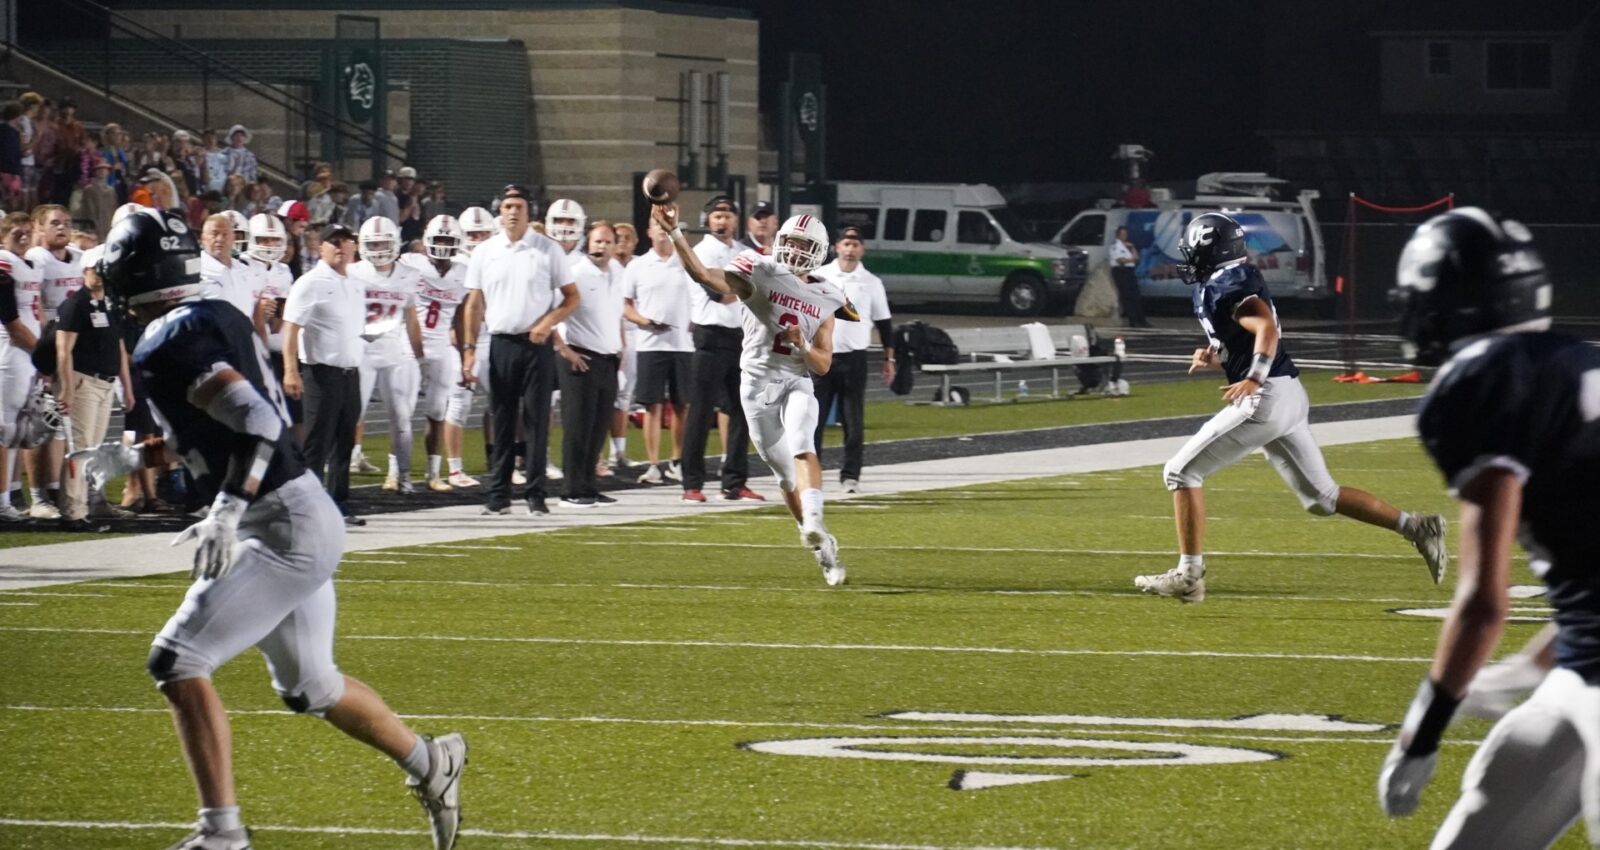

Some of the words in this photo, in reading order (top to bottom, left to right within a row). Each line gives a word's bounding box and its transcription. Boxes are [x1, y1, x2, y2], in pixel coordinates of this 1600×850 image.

[160, 236, 181, 251] 62
[425, 300, 441, 329] 6
[768, 290, 821, 319] WHITEHALL
[772, 312, 799, 356] 2
